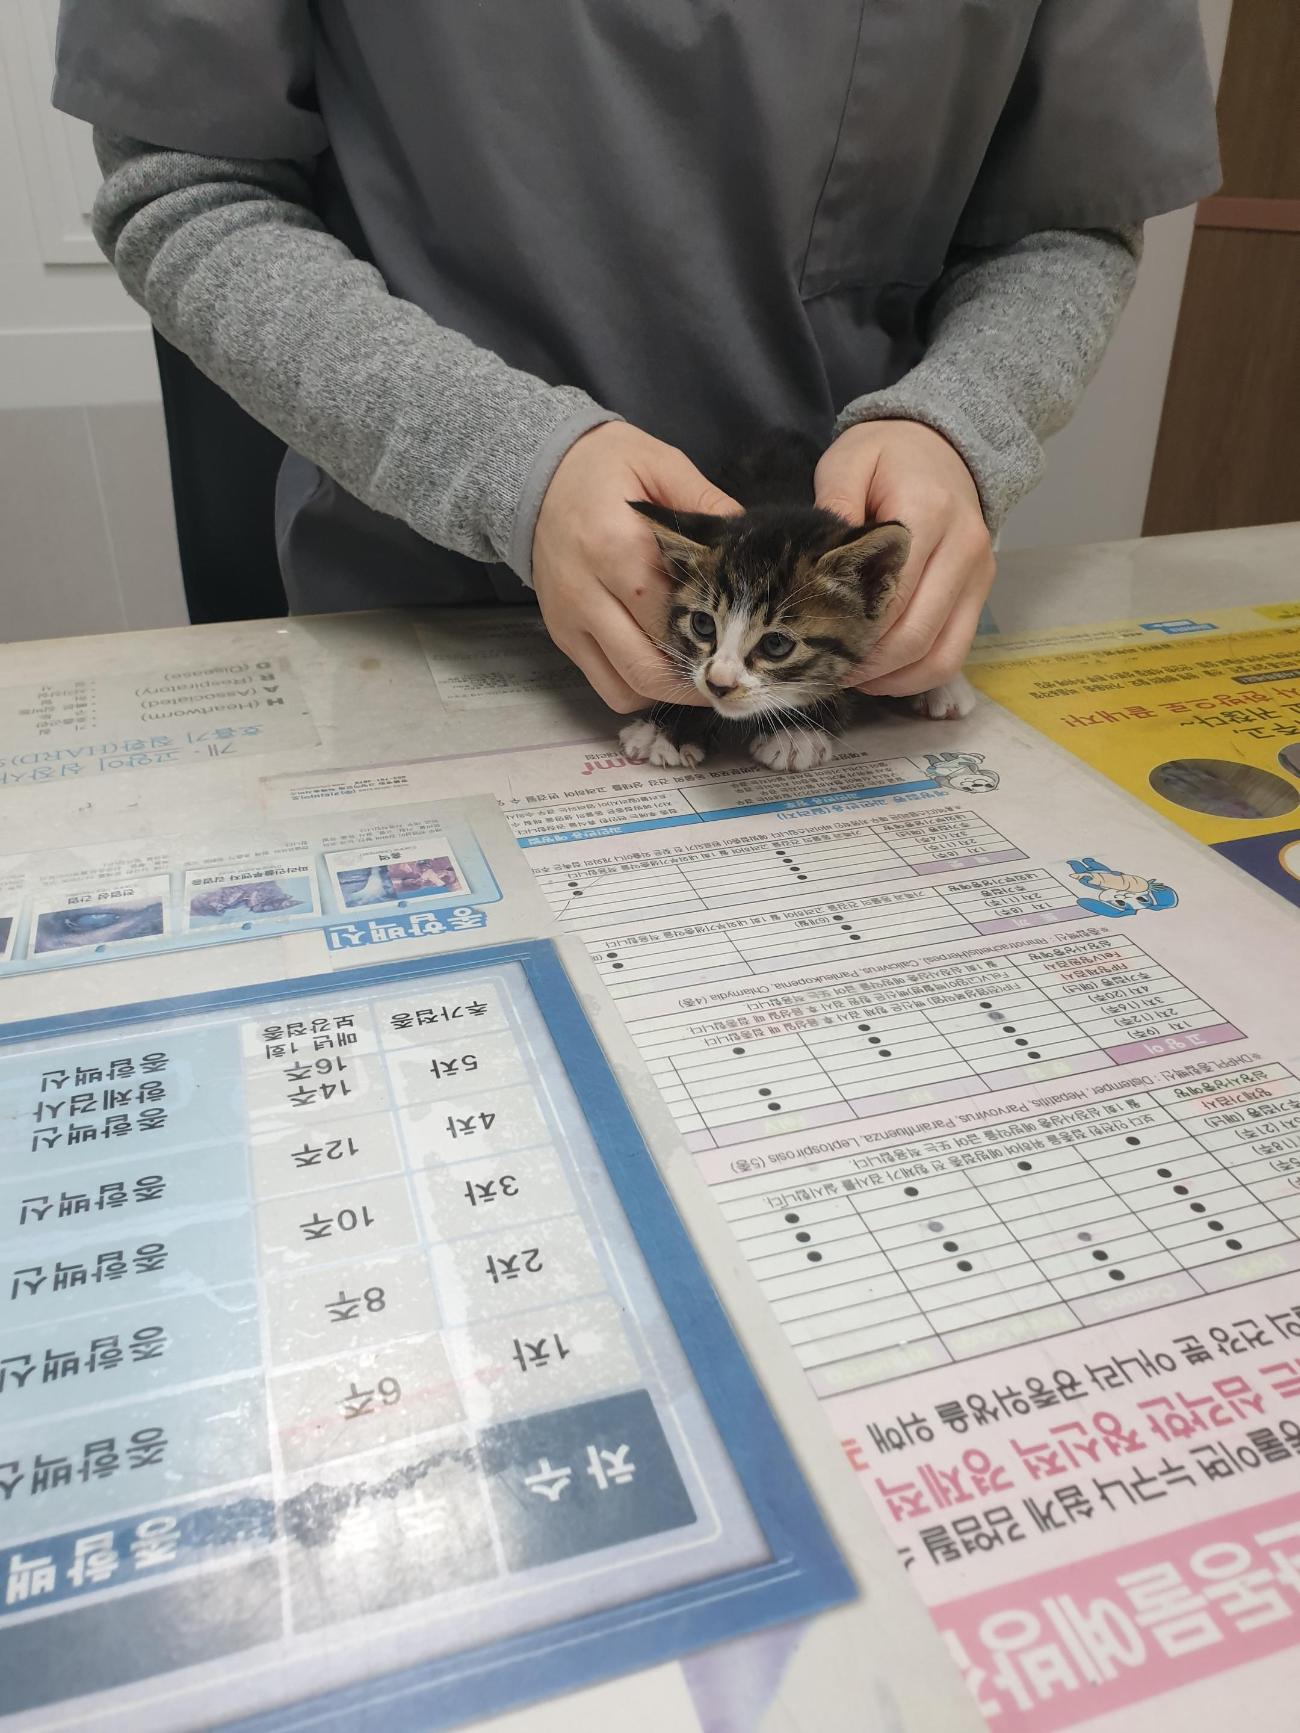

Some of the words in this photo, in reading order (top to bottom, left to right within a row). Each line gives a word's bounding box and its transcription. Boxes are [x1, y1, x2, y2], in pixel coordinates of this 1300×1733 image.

[138, 686, 259, 709] (Associated)
[138, 699, 261, 723] (Heartworm)
[1157, 687, 1271, 716] 한방으로
[1060, 702, 1157, 729] 끝내자!
[1179, 704, 1280, 731] 귀찮다~
[323, 904, 487, 951] 종합백신
[708, 985, 771, 1002] Chlamydia
[1085, 989, 1128, 1002] (20주)
[1125, 984, 1152, 995] 4차
[1139, 996, 1166, 1006] 3차
[387, 998, 492, 1031] 추가접종
[1098, 1000, 1142, 1015] (16주)
[1110, 1012, 1155, 1027] (12주)
[1152, 1007, 1179, 1018] 2차
[260, 1012, 357, 1042] 보강접종
[1124, 1026, 1162, 1039] (9주)
[1166, 1019, 1194, 1031] 1차
[263, 1039, 300, 1059] 1회
[311, 1029, 358, 1050] 매년
[36, 1050, 170, 1093] 종합백신
[280, 1053, 349, 1082] 16주
[426, 1052, 481, 1080] 5차
[31, 1079, 166, 1122] 항체검사
[283, 1076, 353, 1108] 14주
[1034, 1106, 1103, 1129] 심장사상충
[1099, 1101, 1126, 1115] 1회
[1124, 1112, 1158, 1127] 보다
[1199, 1109, 1246, 1128] (매년)
[27, 1105, 168, 1153] 종합백신
[441, 1106, 500, 1139] 4차
[980, 1120, 1039, 1141] 예방약을
[1042, 1127, 1089, 1146] 접종을
[1083, 1118, 1131, 1137] 안전한
[1230, 1120, 1281, 1140] (21주)
[287, 1132, 362, 1169] 12주
[765, 1135, 861, 1165] Leptospirosis
[920, 1138, 953, 1154] 또는
[950, 1131, 983, 1148] 급여
[1001, 1136, 1046, 1155] 위하여
[1247, 1135, 1300, 1156] (18주)
[846, 1144, 923, 1171] 적용합니다.
[927, 1157, 947, 1171] 전
[944, 1145, 1005, 1168] 예방접종
[839, 1171, 885, 1191] 검사를
[883, 1161, 930, 1181] 항체가
[16, 1171, 167, 1226] 종합백신
[459, 1170, 522, 1207] 3차
[761, 1181, 840, 1209] 실시합니다.
[296, 1200, 377, 1242] 10주
[7, 1238, 169, 1301] 종합백신
[480, 1243, 546, 1284] 2차
[321, 1280, 388, 1325] 8주
[506, 1326, 573, 1373] 1차
[1169, 1332, 1216, 1367] 뿐
[1201, 1316, 1276, 1358] 건강
[1077, 1341, 1183, 1393] 아니라
[332, 1369, 404, 1421] 6주
[929, 1365, 1091, 1435] 공중위생을
[1130, 1372, 1276, 1445] 심각한
[862, 1406, 937, 1454] 위해
[1006, 1406, 1150, 1482] 정신적
[871, 1442, 1017, 1522] 경제적
[1086, 1452, 1202, 1515] 누구나
[1019, 1481, 1101, 1536] 쉽게
[915, 1502, 1030, 1568] 감염될
[938, 1521, 1300, 1721] 동물예방
